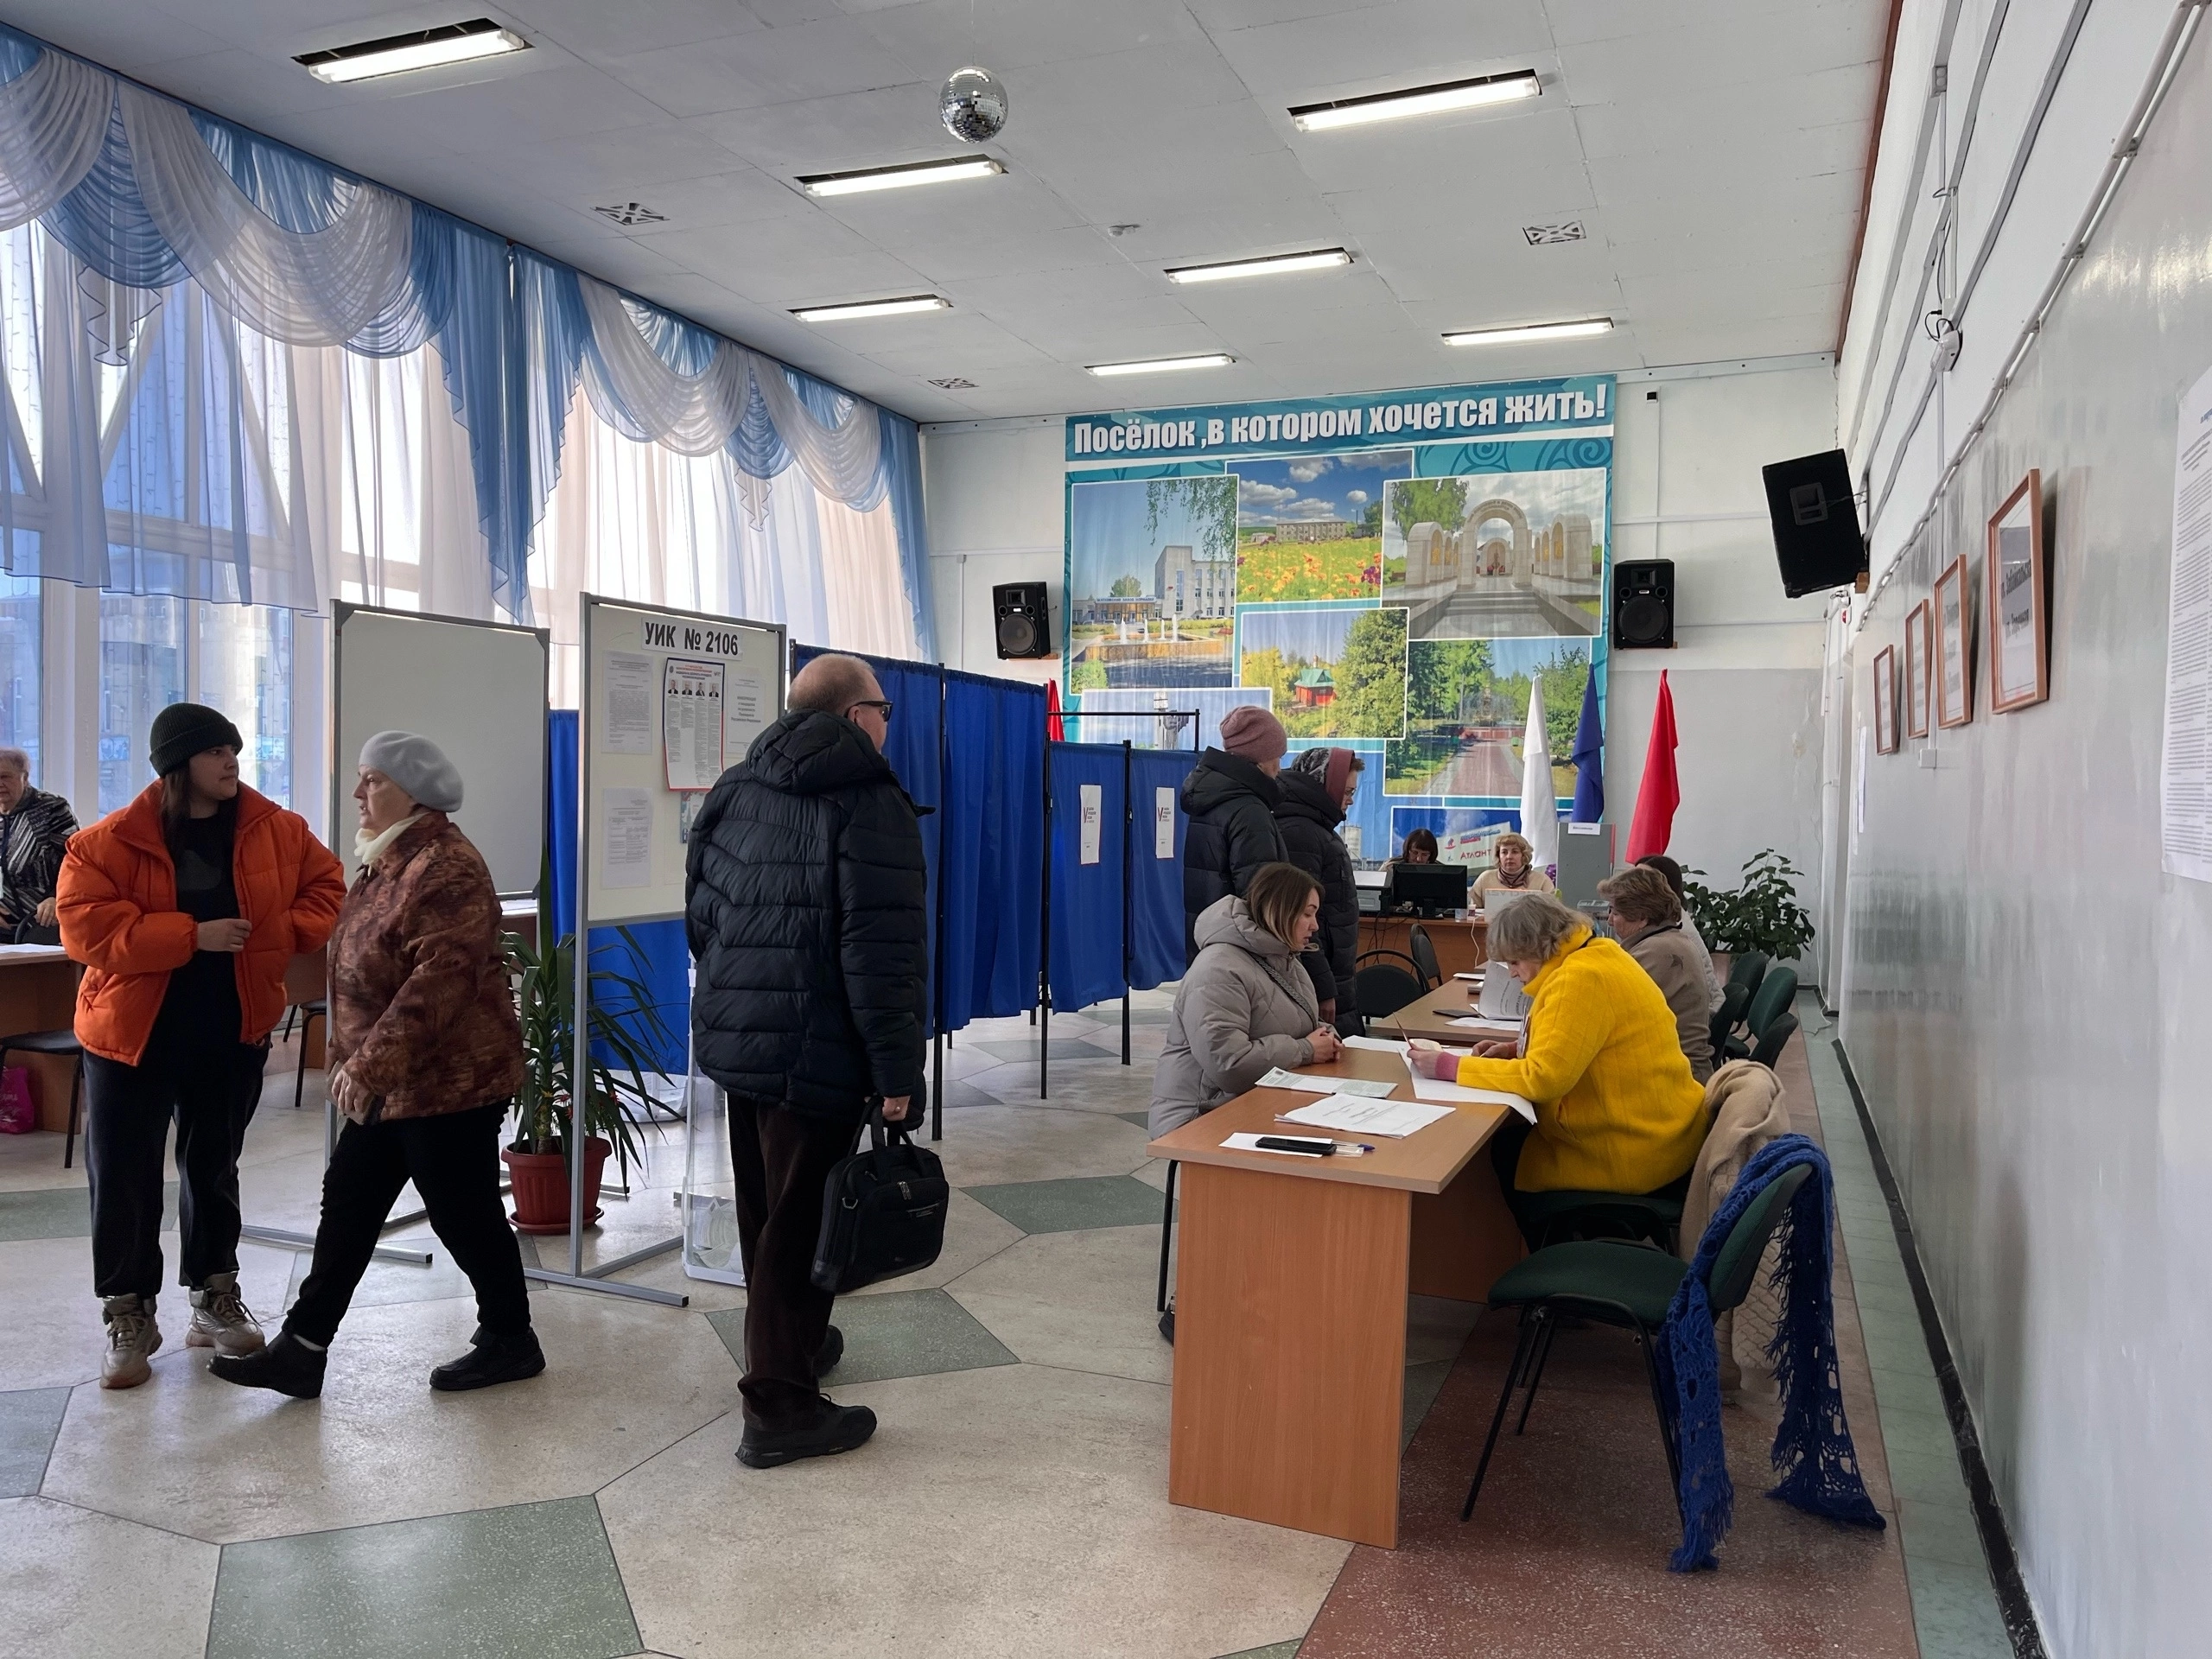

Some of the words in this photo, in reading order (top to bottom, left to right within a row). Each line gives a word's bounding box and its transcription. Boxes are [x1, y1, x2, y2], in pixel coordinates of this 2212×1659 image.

[1074, 418, 1196, 454] Посёлок
[1231, 408, 1362, 443] котором
[1368, 397, 1497, 435] хочется
[1503, 384, 1607, 424] жить!
[645, 621, 677, 648] УИК
[684, 627, 701, 651] №
[705, 630, 739, 656] 2106
